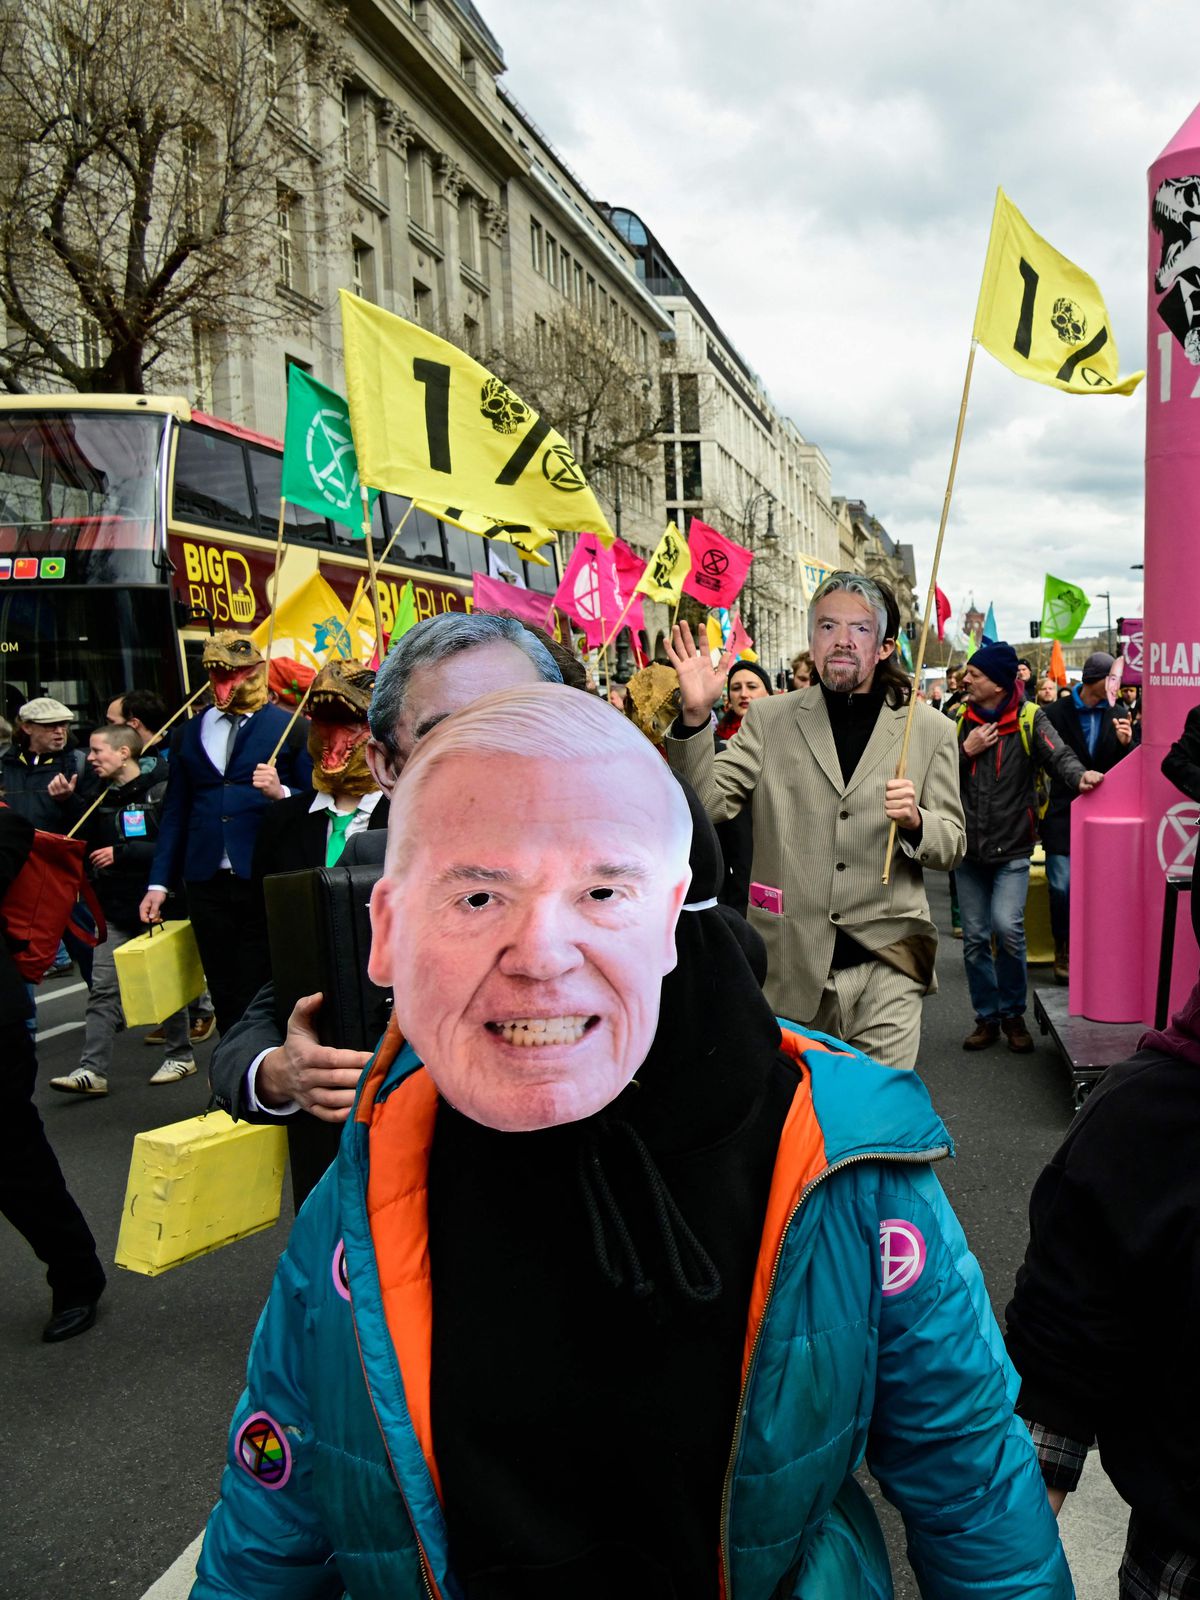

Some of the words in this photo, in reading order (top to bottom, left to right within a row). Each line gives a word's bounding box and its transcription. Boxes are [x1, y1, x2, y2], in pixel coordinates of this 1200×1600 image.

[183, 543, 224, 585] BIG
[189, 584, 230, 622] BUS
[1150, 675, 1161, 686] FOR
